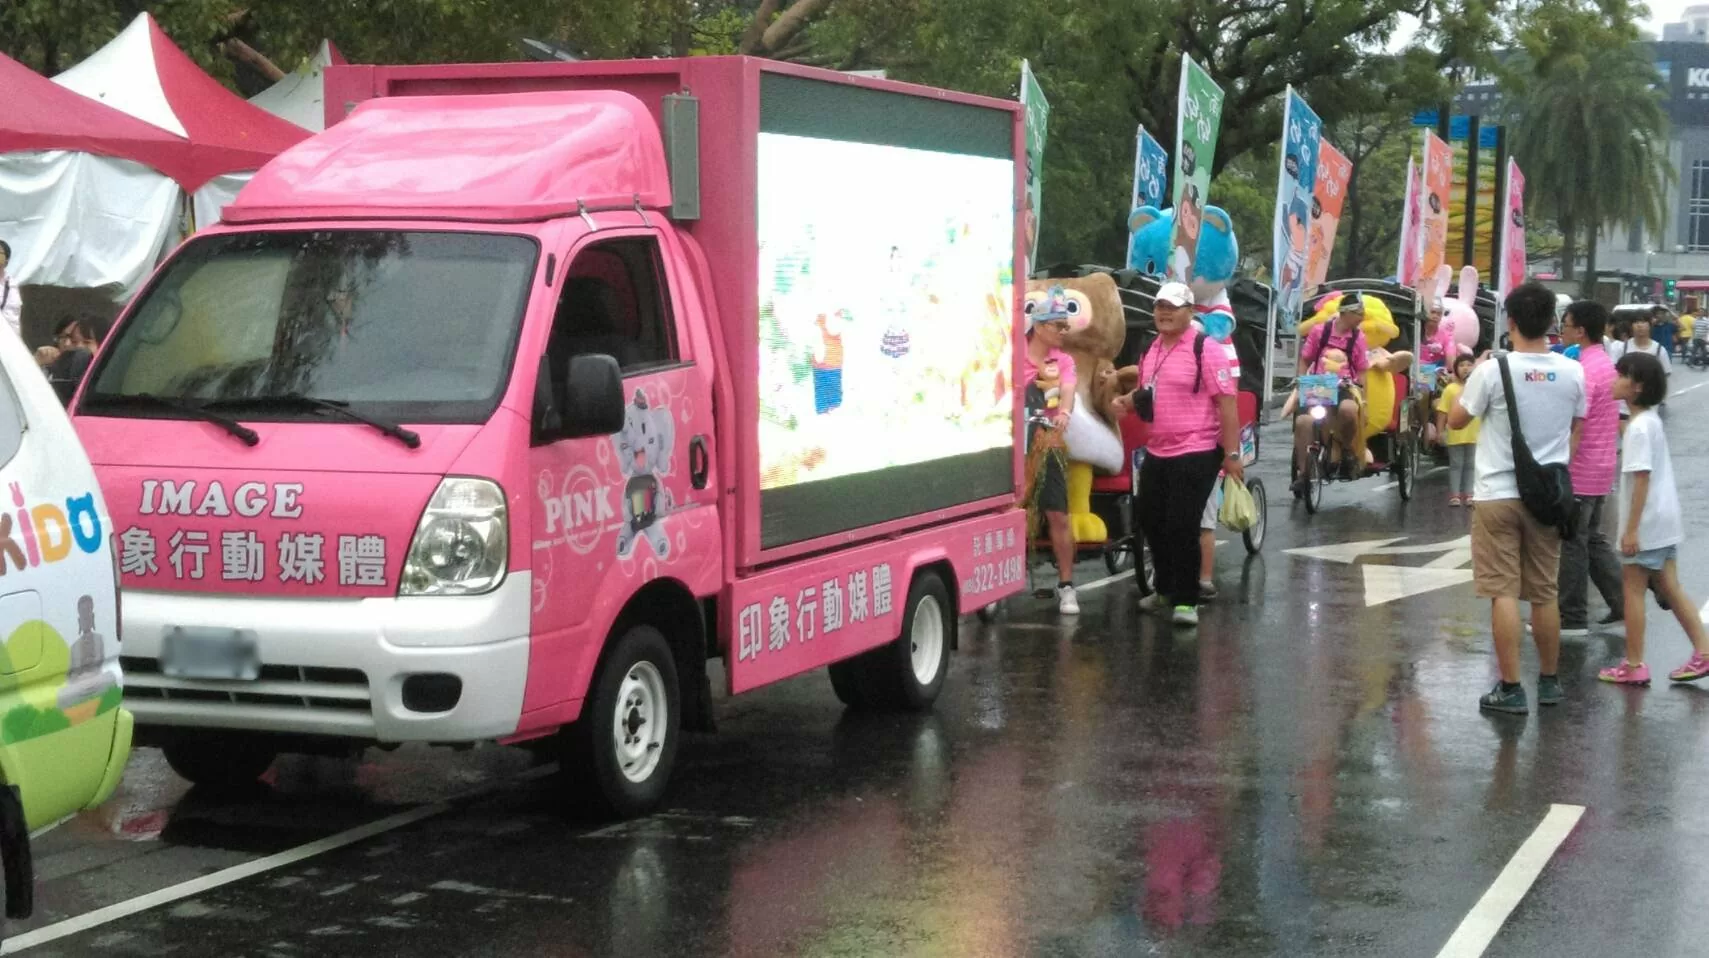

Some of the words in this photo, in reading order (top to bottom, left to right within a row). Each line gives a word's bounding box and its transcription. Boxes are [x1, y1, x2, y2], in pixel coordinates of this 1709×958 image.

[139, 480, 305, 519] IMAGE
[543, 486, 614, 533] PINK
[121, 526, 388, 586] 象行動媒體
[739, 563, 892, 661] 印象行動媒體
